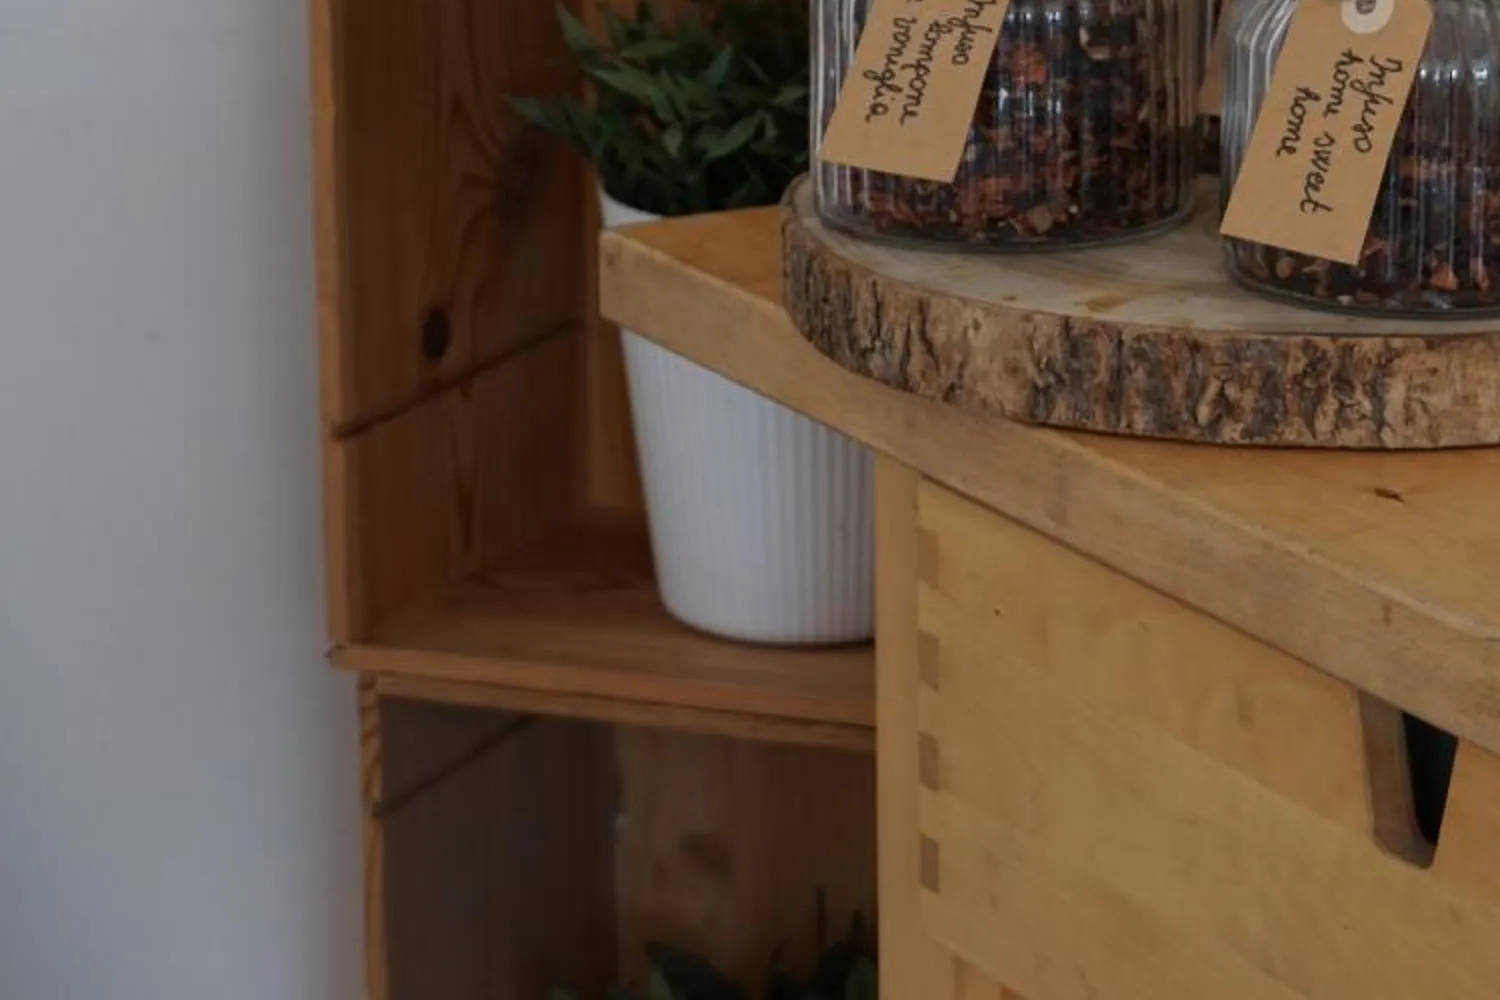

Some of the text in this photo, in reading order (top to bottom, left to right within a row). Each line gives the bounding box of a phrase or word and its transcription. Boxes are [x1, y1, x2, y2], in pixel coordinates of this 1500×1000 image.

[1275, 87, 1322, 158] home
[1299, 48, 1365, 214] home sweet
[1349, 55, 1404, 153] Infuso
